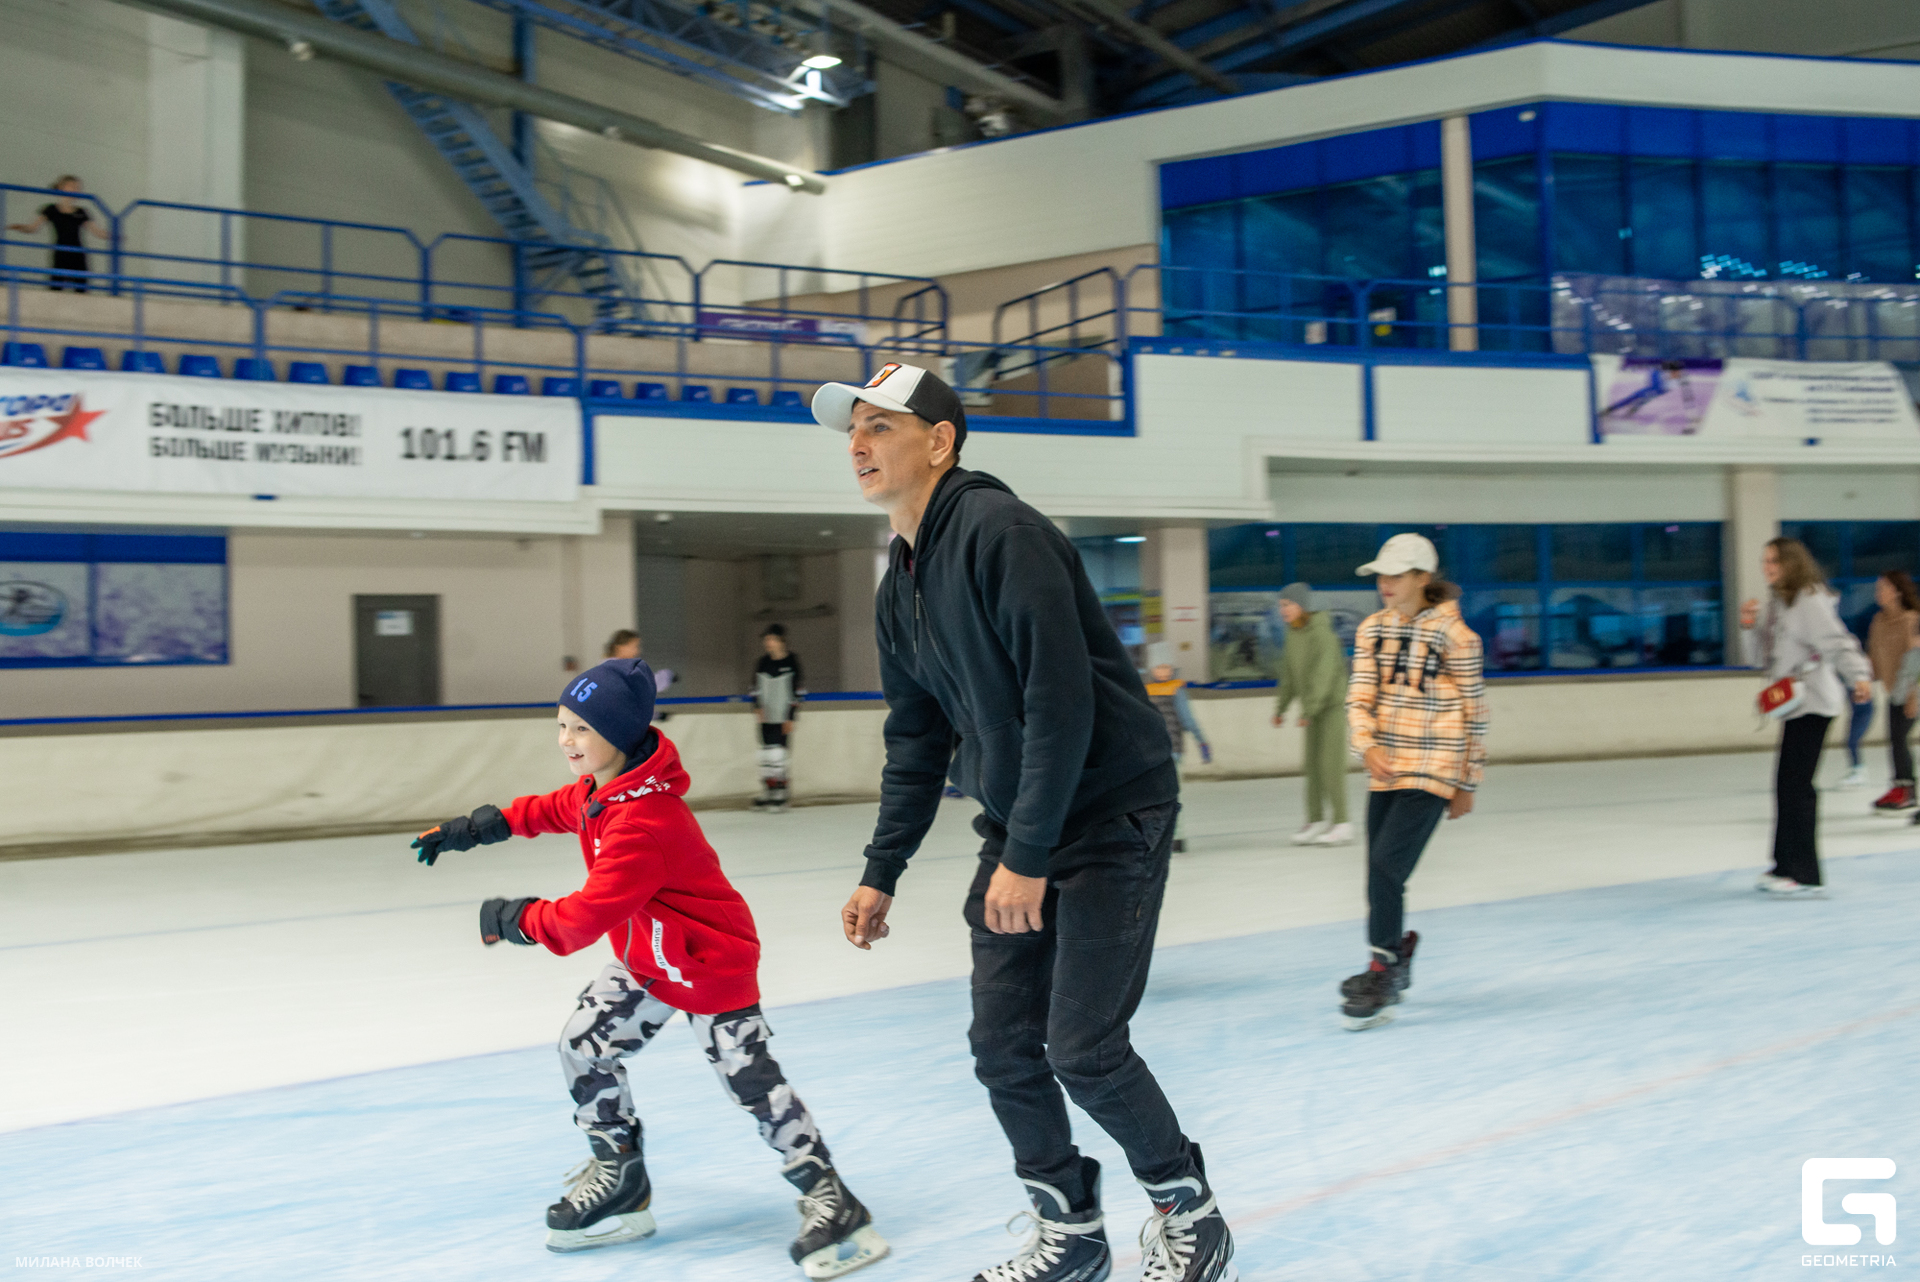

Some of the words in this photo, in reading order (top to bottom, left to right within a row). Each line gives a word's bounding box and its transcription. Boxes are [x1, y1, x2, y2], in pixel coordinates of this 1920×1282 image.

[150, 402, 262, 433] БОЛЬШЕ
[150, 436, 247, 462] БОЛЬШЕ
[400, 426, 491, 461] 101.6
[502, 430, 547, 462] FM
[570, 677, 598, 702] 15
